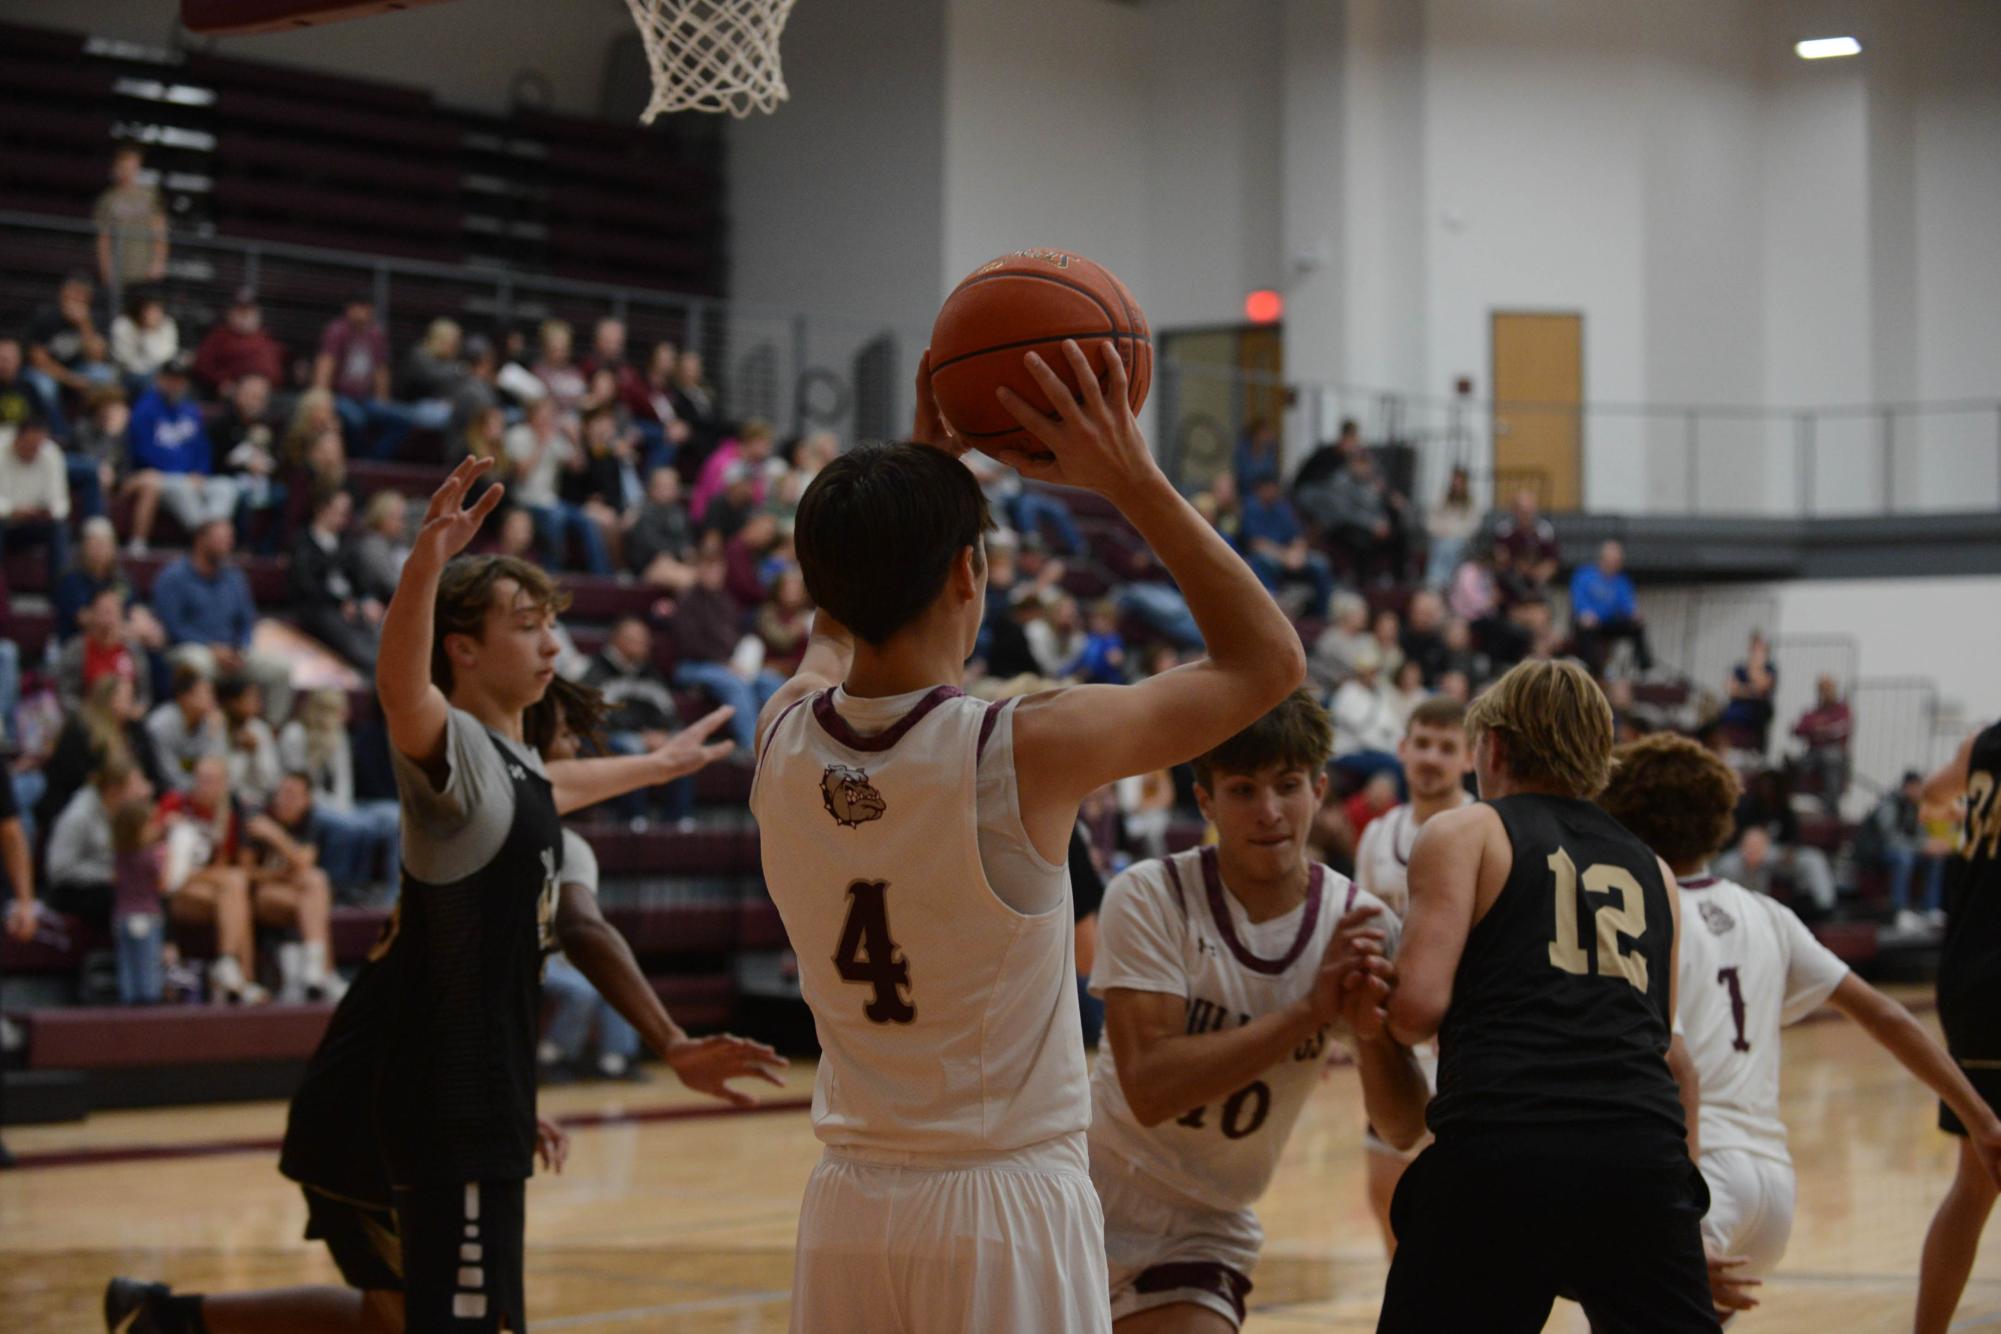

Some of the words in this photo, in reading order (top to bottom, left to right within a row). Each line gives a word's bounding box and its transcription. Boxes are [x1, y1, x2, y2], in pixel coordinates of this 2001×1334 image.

[830, 877, 918, 1026] 4
[1547, 845, 1649, 994] 12
[1718, 965, 1750, 1052] 1
